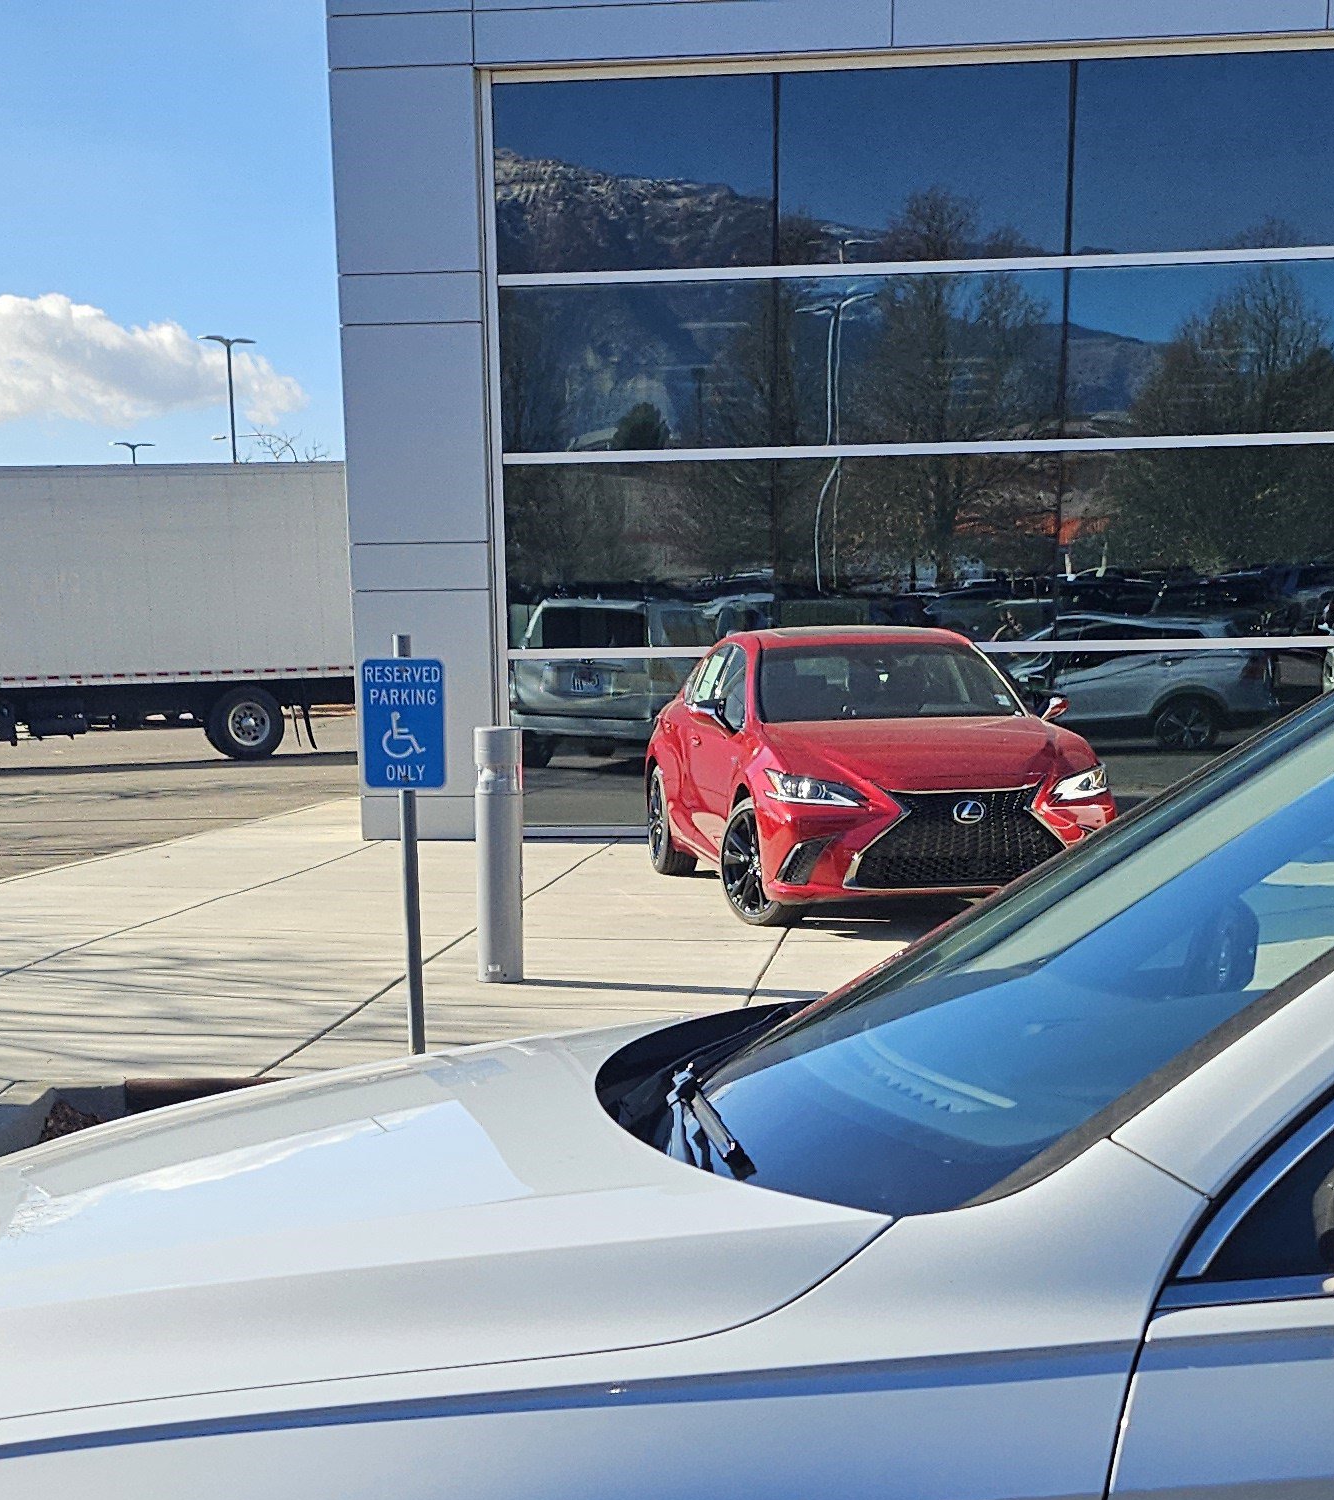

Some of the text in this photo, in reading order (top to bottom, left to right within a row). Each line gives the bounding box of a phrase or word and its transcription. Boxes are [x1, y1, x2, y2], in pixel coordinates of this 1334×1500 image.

[364, 666, 441, 683] RESERVED
[369, 689, 436, 706] PARKING
[386, 765, 425, 781] ONLY
